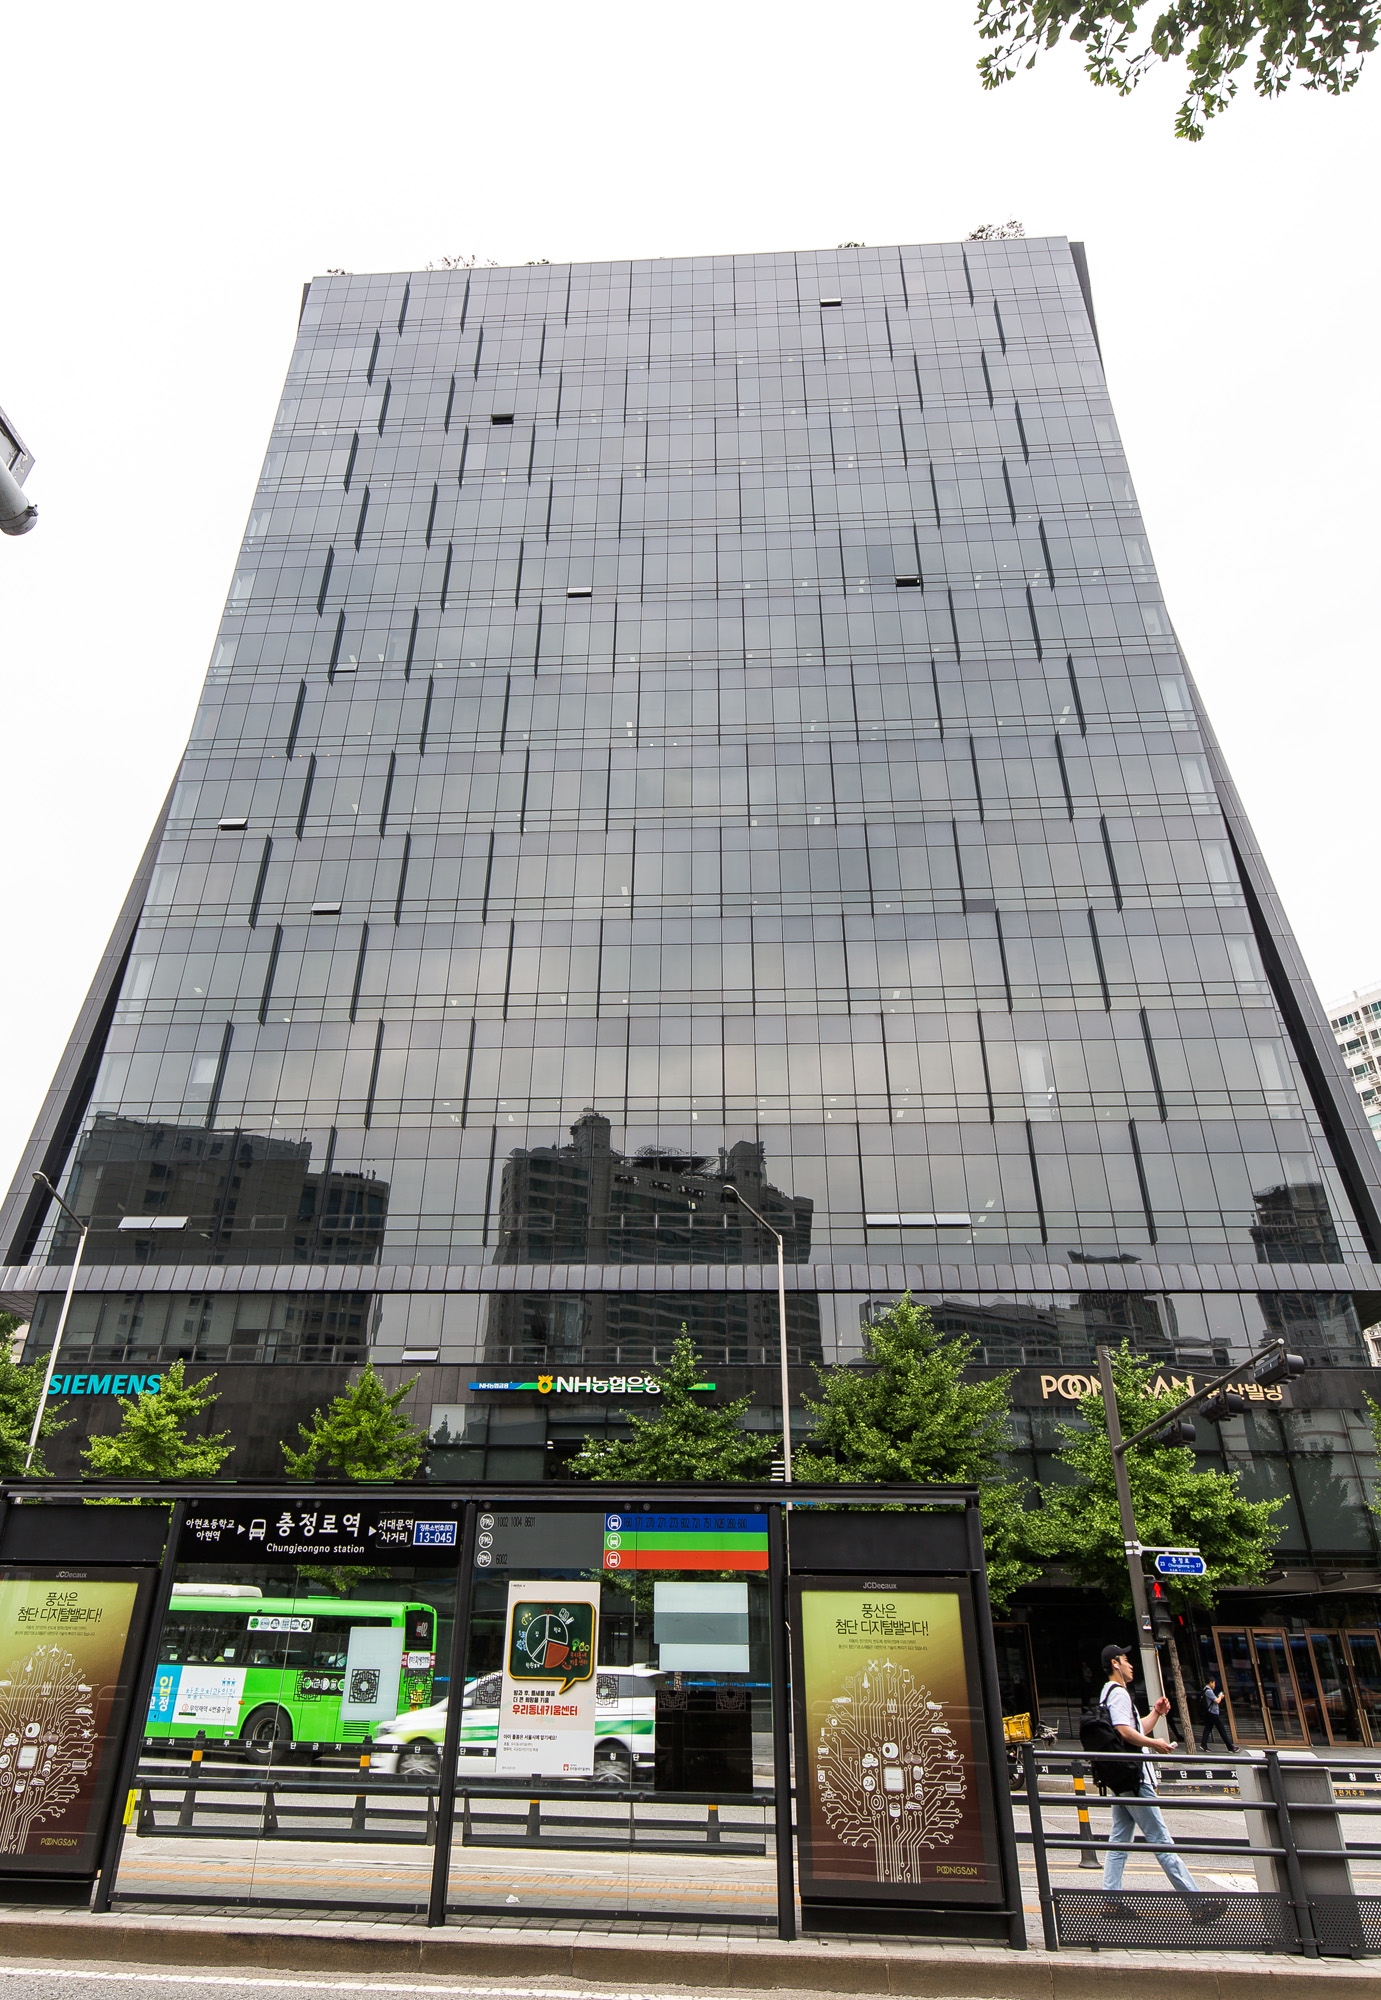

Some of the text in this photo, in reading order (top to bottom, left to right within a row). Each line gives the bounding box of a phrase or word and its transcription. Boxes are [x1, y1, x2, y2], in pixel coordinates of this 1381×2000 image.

[47, 1374, 161, 1395] SIEMENS
[185, 1518, 235, 1529] 아현초등학교
[276, 1512, 360, 1537] 충정로역
[377, 1519, 414, 1530] 서대문역
[497, 1517, 508, 1527] 1002
[658, 1517, 666, 1529] 271
[196, 1530, 221, 1541] 아현역
[379, 1531, 408, 1543] 사거리
[419, 1532, 452, 1543] 13-045
[266, 1543, 365, 1554] Chungjeongno station
[495, 1554, 508, 1564] 6002
[862, 1582, 897, 1590] JCDecaux
[46, 1592, 78, 1606] 풍산은
[18, 1606, 103, 1623] 첨단 디지털밸리다!
[861, 1603, 898, 1619] 풍산은
[835, 1619, 929, 1636] 첨단 디지털밸리다!
[512, 1704, 578, 1716] 우리동네키움센터
[168, 1738, 175, 1746] 지
[335, 1743, 341, 1751] 지
[1041, 1766, 1049, 1774] 지
[1180, 1770, 1187, 1779] 단
[1205, 1770, 1213, 1779] 금
[41, 1837, 78, 1847] POONGSAN
[936, 1865, 978, 1875] POONGSAN
